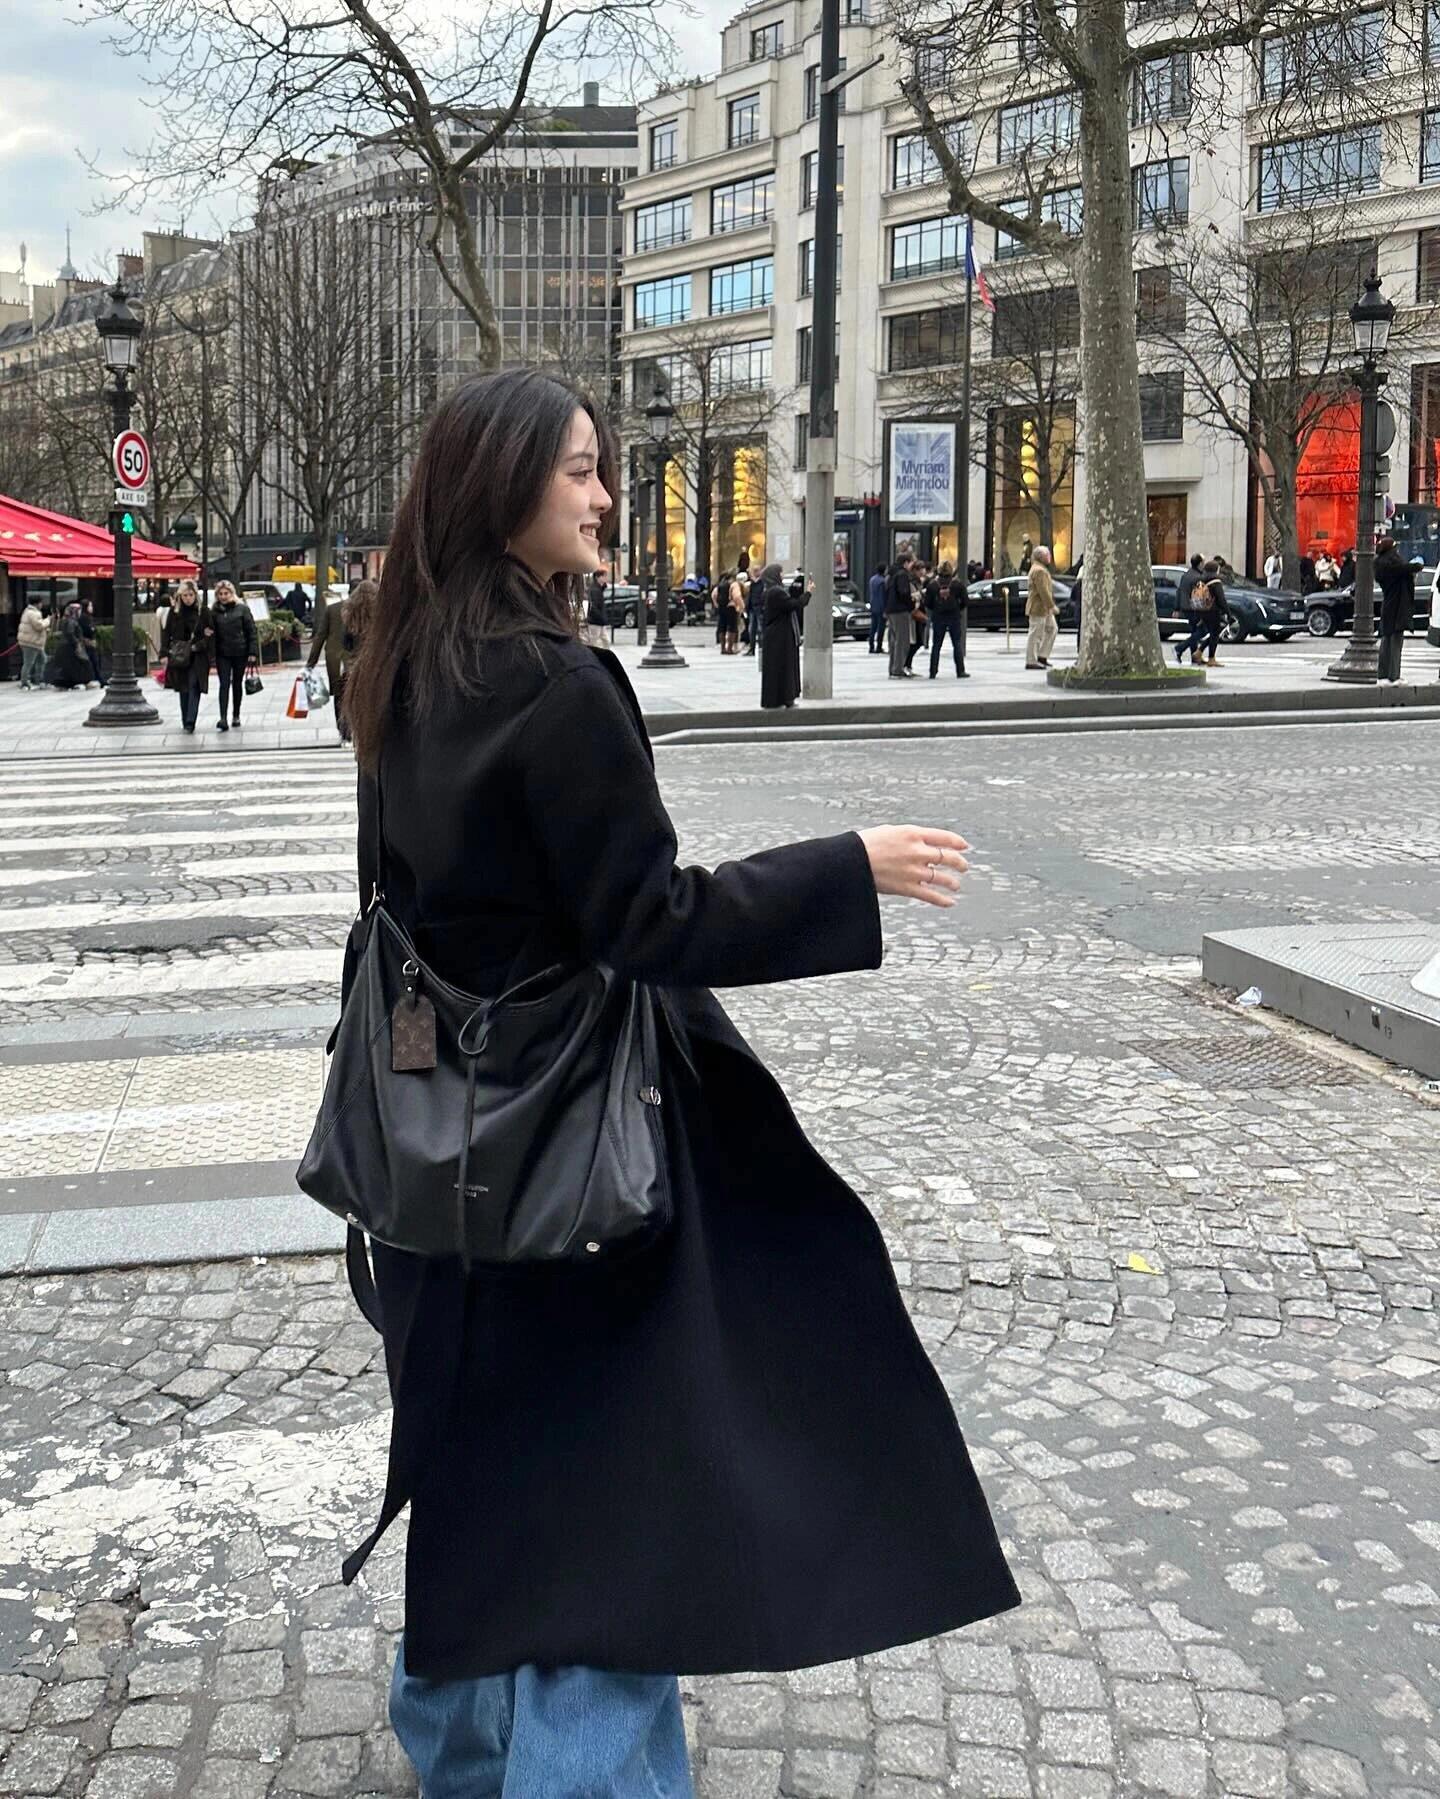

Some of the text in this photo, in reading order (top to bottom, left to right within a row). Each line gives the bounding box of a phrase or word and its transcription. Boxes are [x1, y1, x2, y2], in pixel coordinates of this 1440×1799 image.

[124, 448, 143, 473] 50
[901, 460, 945, 477] Myriam
[896, 475, 949, 490] Mihindou
[121, 490, 134, 502] AXE
